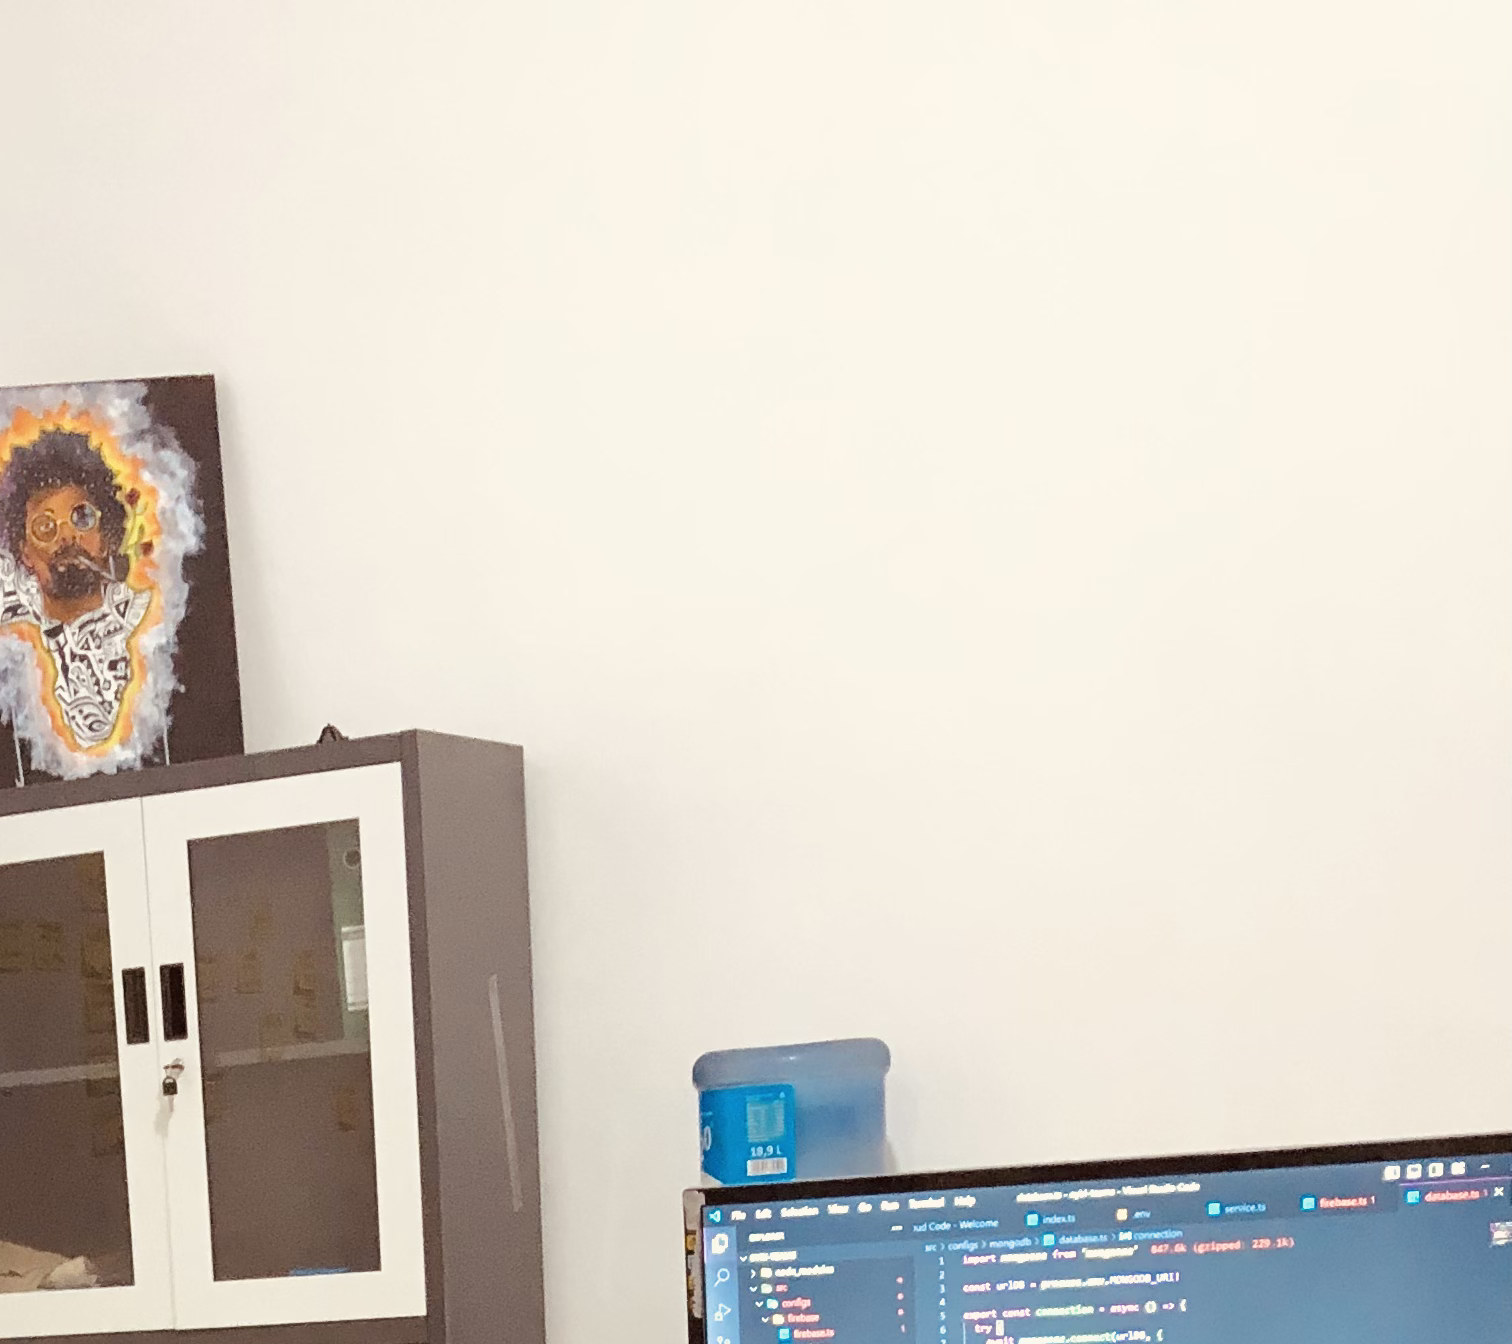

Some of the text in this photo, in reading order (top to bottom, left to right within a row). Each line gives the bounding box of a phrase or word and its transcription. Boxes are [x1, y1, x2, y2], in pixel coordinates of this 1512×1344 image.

[750, 1145, 774, 1157] 18,9
[1224, 1202, 1266, 1214] service.ts
[1042, 1214, 1076, 1225] index.ts
[1133, 1210, 1150, 1219] .env
[929, 1219, 999, 1231] Code Welcome
[925, 1228, 1183, 1251] src configs mongodb database.ts connection
[1052, 1249, 1077, 1259] from
[963, 1283, 991, 1293] const
[974, 1323, 992, 1334] try
